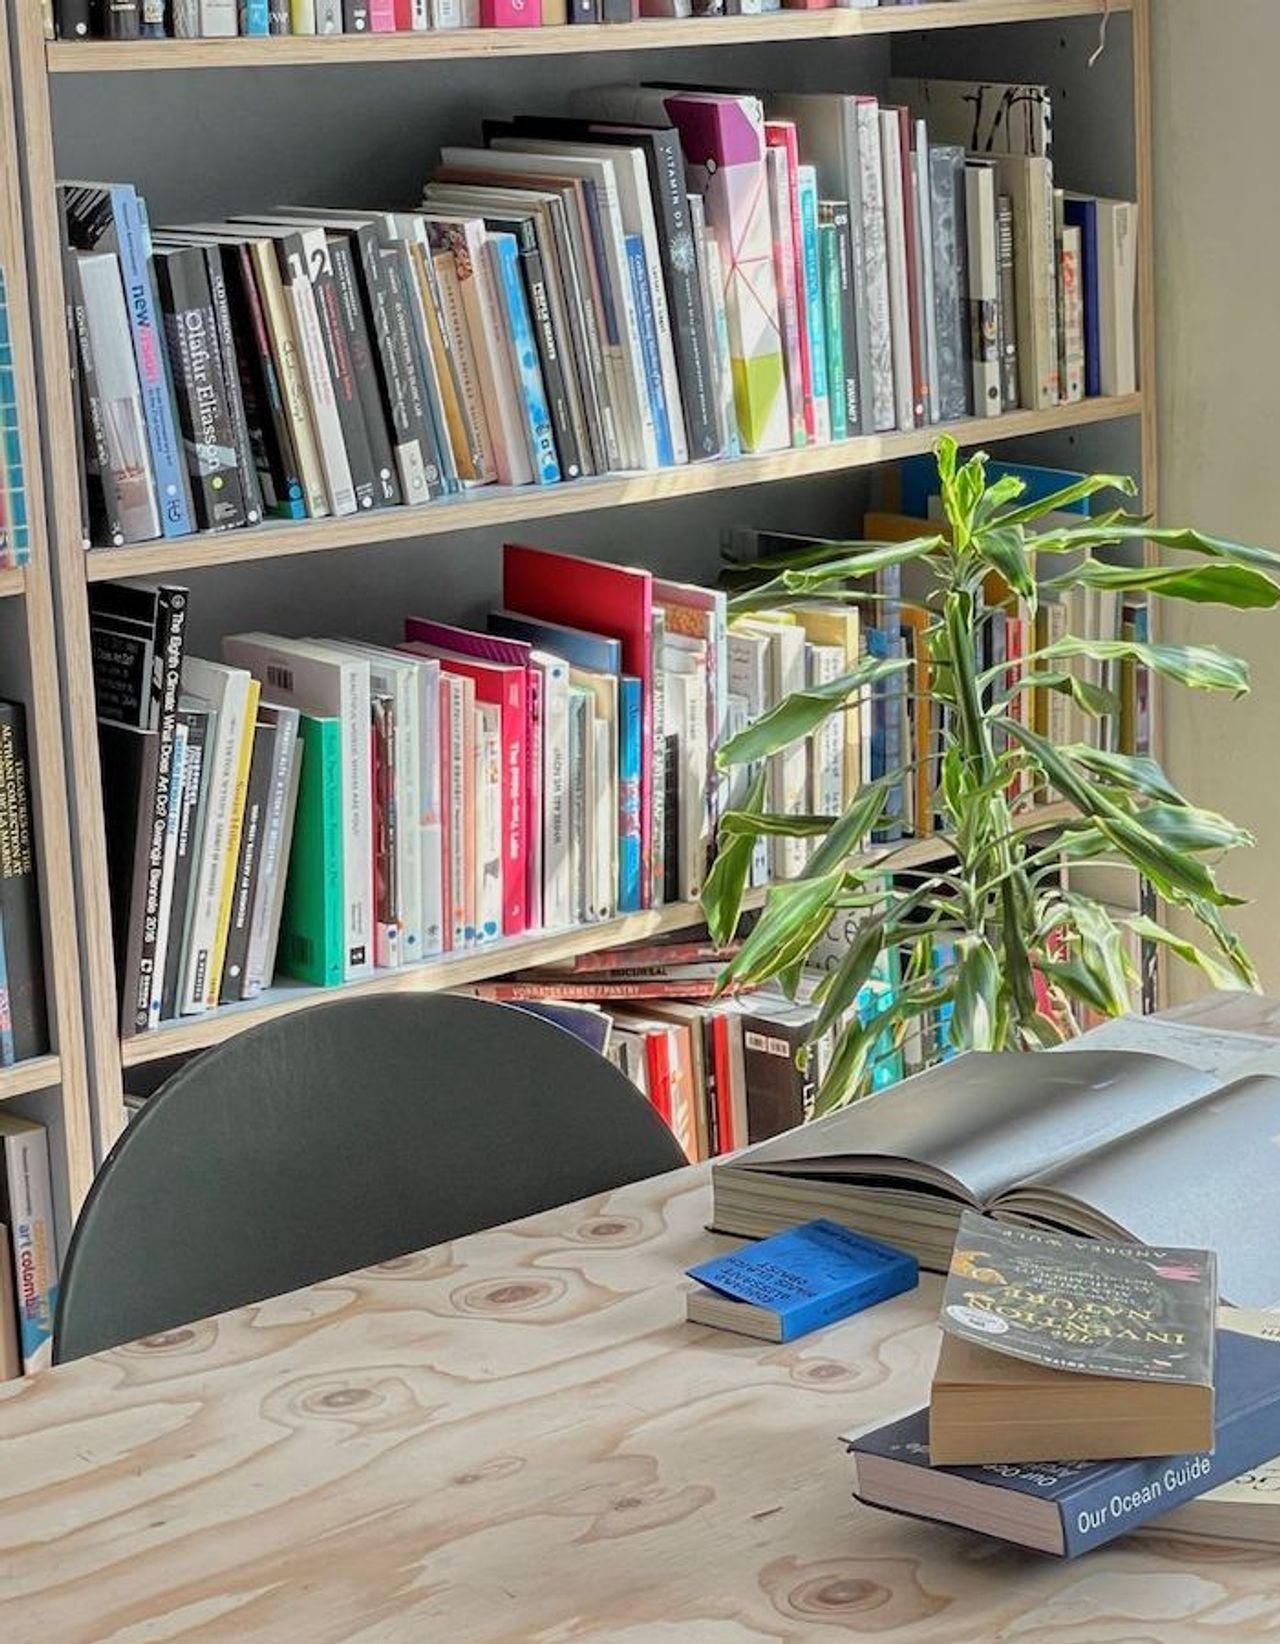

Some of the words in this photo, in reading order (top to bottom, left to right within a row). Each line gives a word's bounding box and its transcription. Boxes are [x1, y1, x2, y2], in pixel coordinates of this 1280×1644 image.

[664, 145, 680, 204] VITAMIN
[673, 211, 682, 228] D3
[311, 249, 330, 285] 2
[130, 283, 152, 327] new
[182, 310, 211, 382] Olafur
[194, 383, 227, 471] Eliasson
[170, 610, 183, 633] The
[165, 635, 181, 669] Eighth
[161, 713, 175, 742] What
[1, 723, 15, 779] AL-THANI
[157, 744, 171, 773] Does
[509, 740, 519, 765] The
[14, 760, 28, 827] TREASURES
[156, 775, 169, 793] Art
[5, 780, 21, 858] COLLECTION
[154, 794, 167, 816] Do?
[149, 819, 164, 865] Gwangju
[146, 868, 160, 913] Biennale
[143, 915, 156, 943] 2016
[603, 985, 640, 996] PANTRY
[18, 1224, 32, 1248] art
[1001, 1229, 1063, 1248] WULF
[1074, 1242, 1168, 1259] ANDREA
[1003, 1285, 1154, 1320] NATURE
[965, 1294, 1187, 1346] INVENTION
[1049, 1330, 1095, 1345] The
[1076, 1503, 1107, 1535] Our
[1110, 1483, 1162, 1518] Ocean
[1163, 1453, 1212, 1492] Guide
